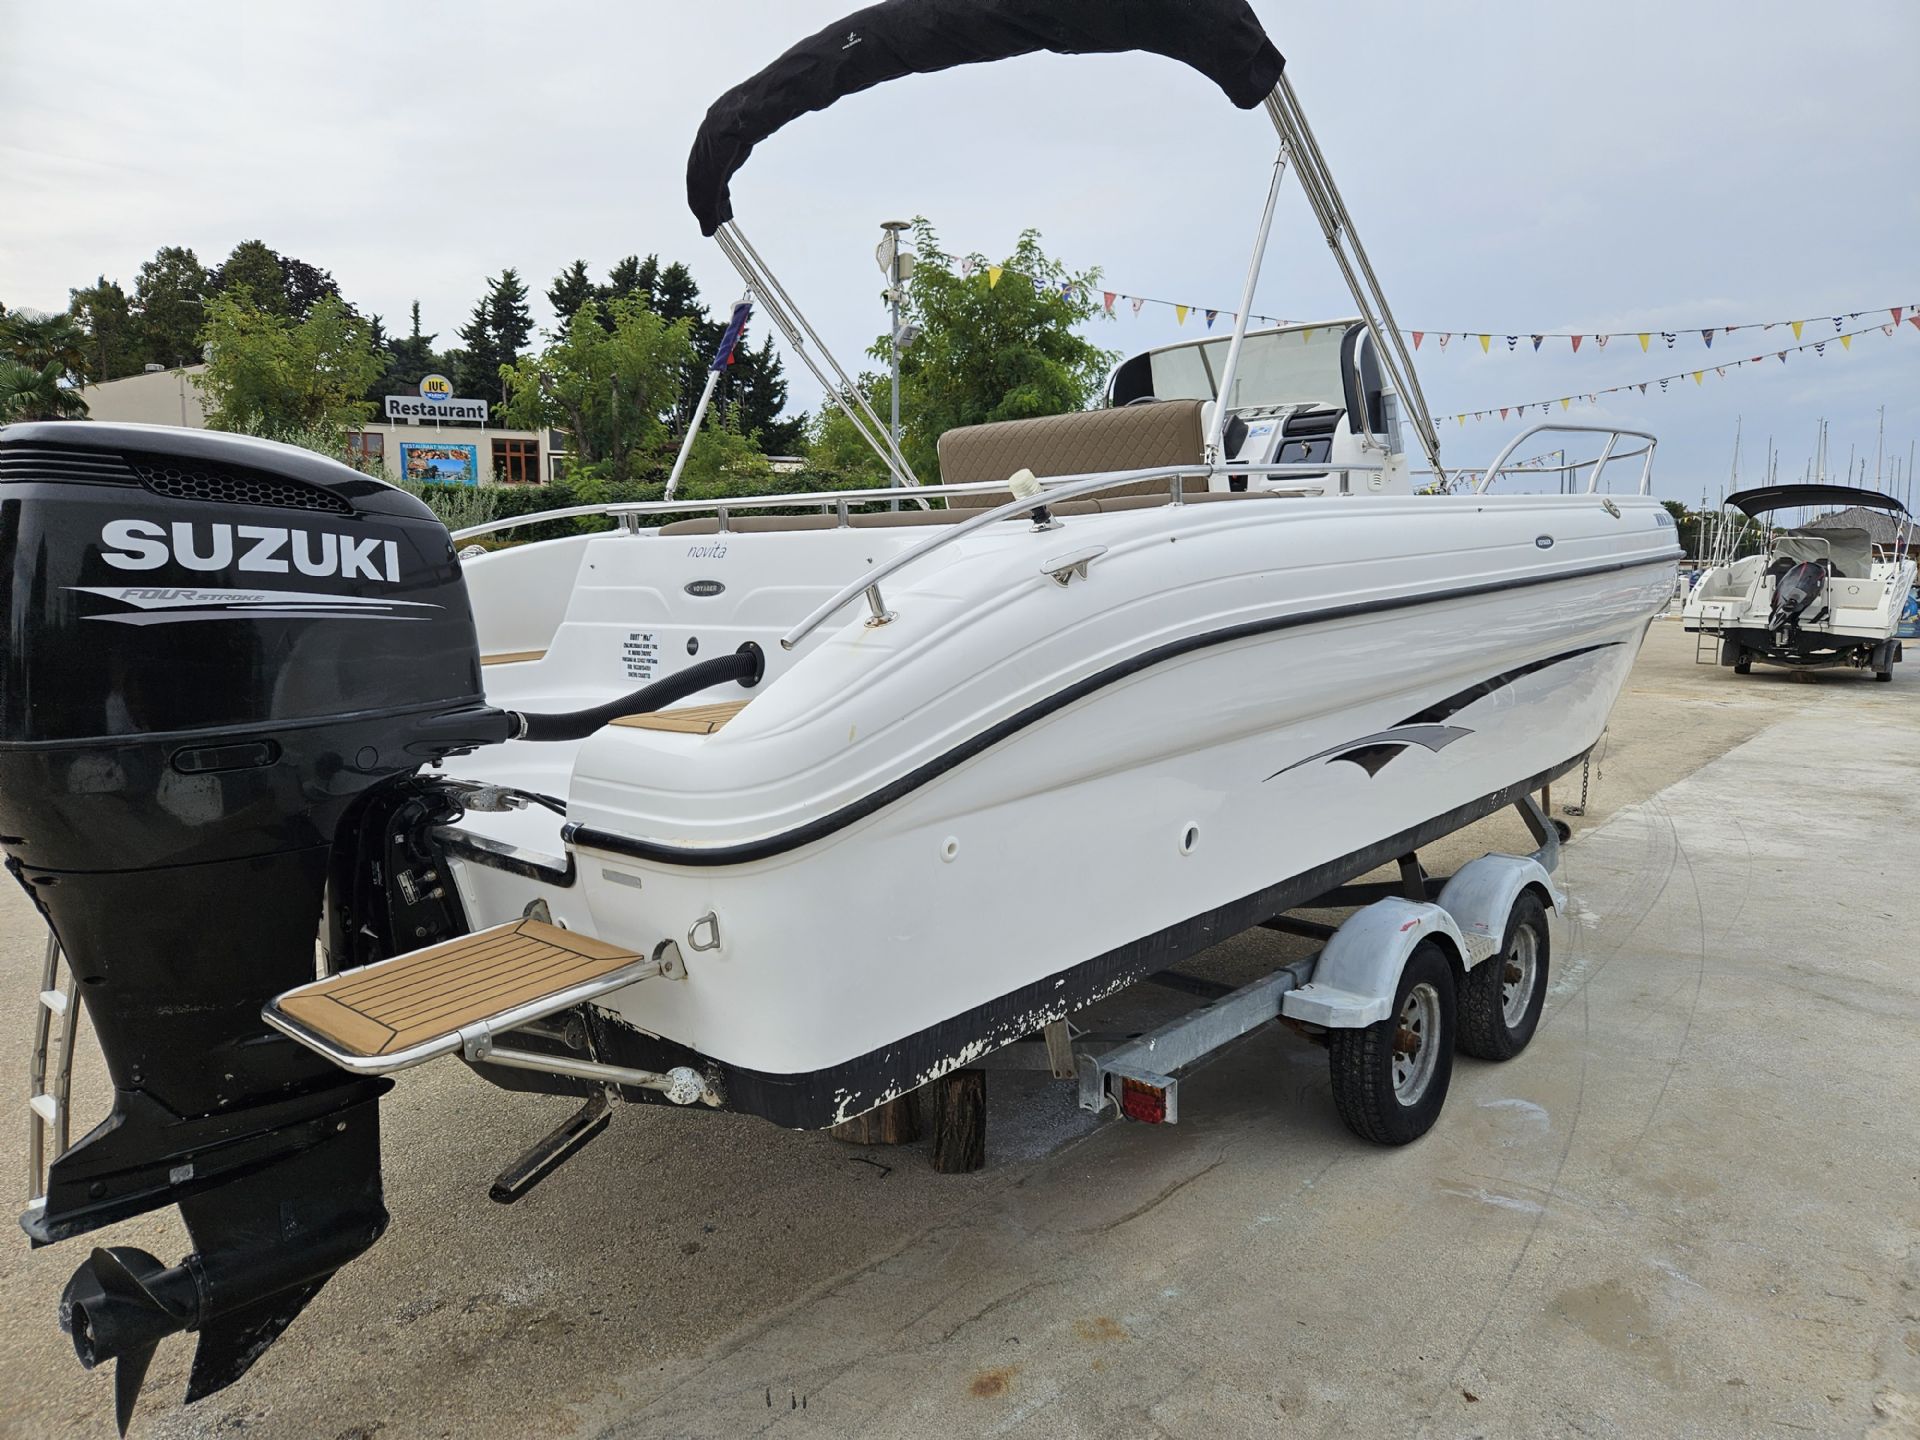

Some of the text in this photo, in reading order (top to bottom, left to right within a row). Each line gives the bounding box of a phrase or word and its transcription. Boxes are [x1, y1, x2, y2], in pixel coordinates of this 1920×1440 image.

[389, 399, 485, 419] Restaurant
[100, 519, 401, 583] SUZUKI
[119, 588, 265, 602] FOUR STROKE
